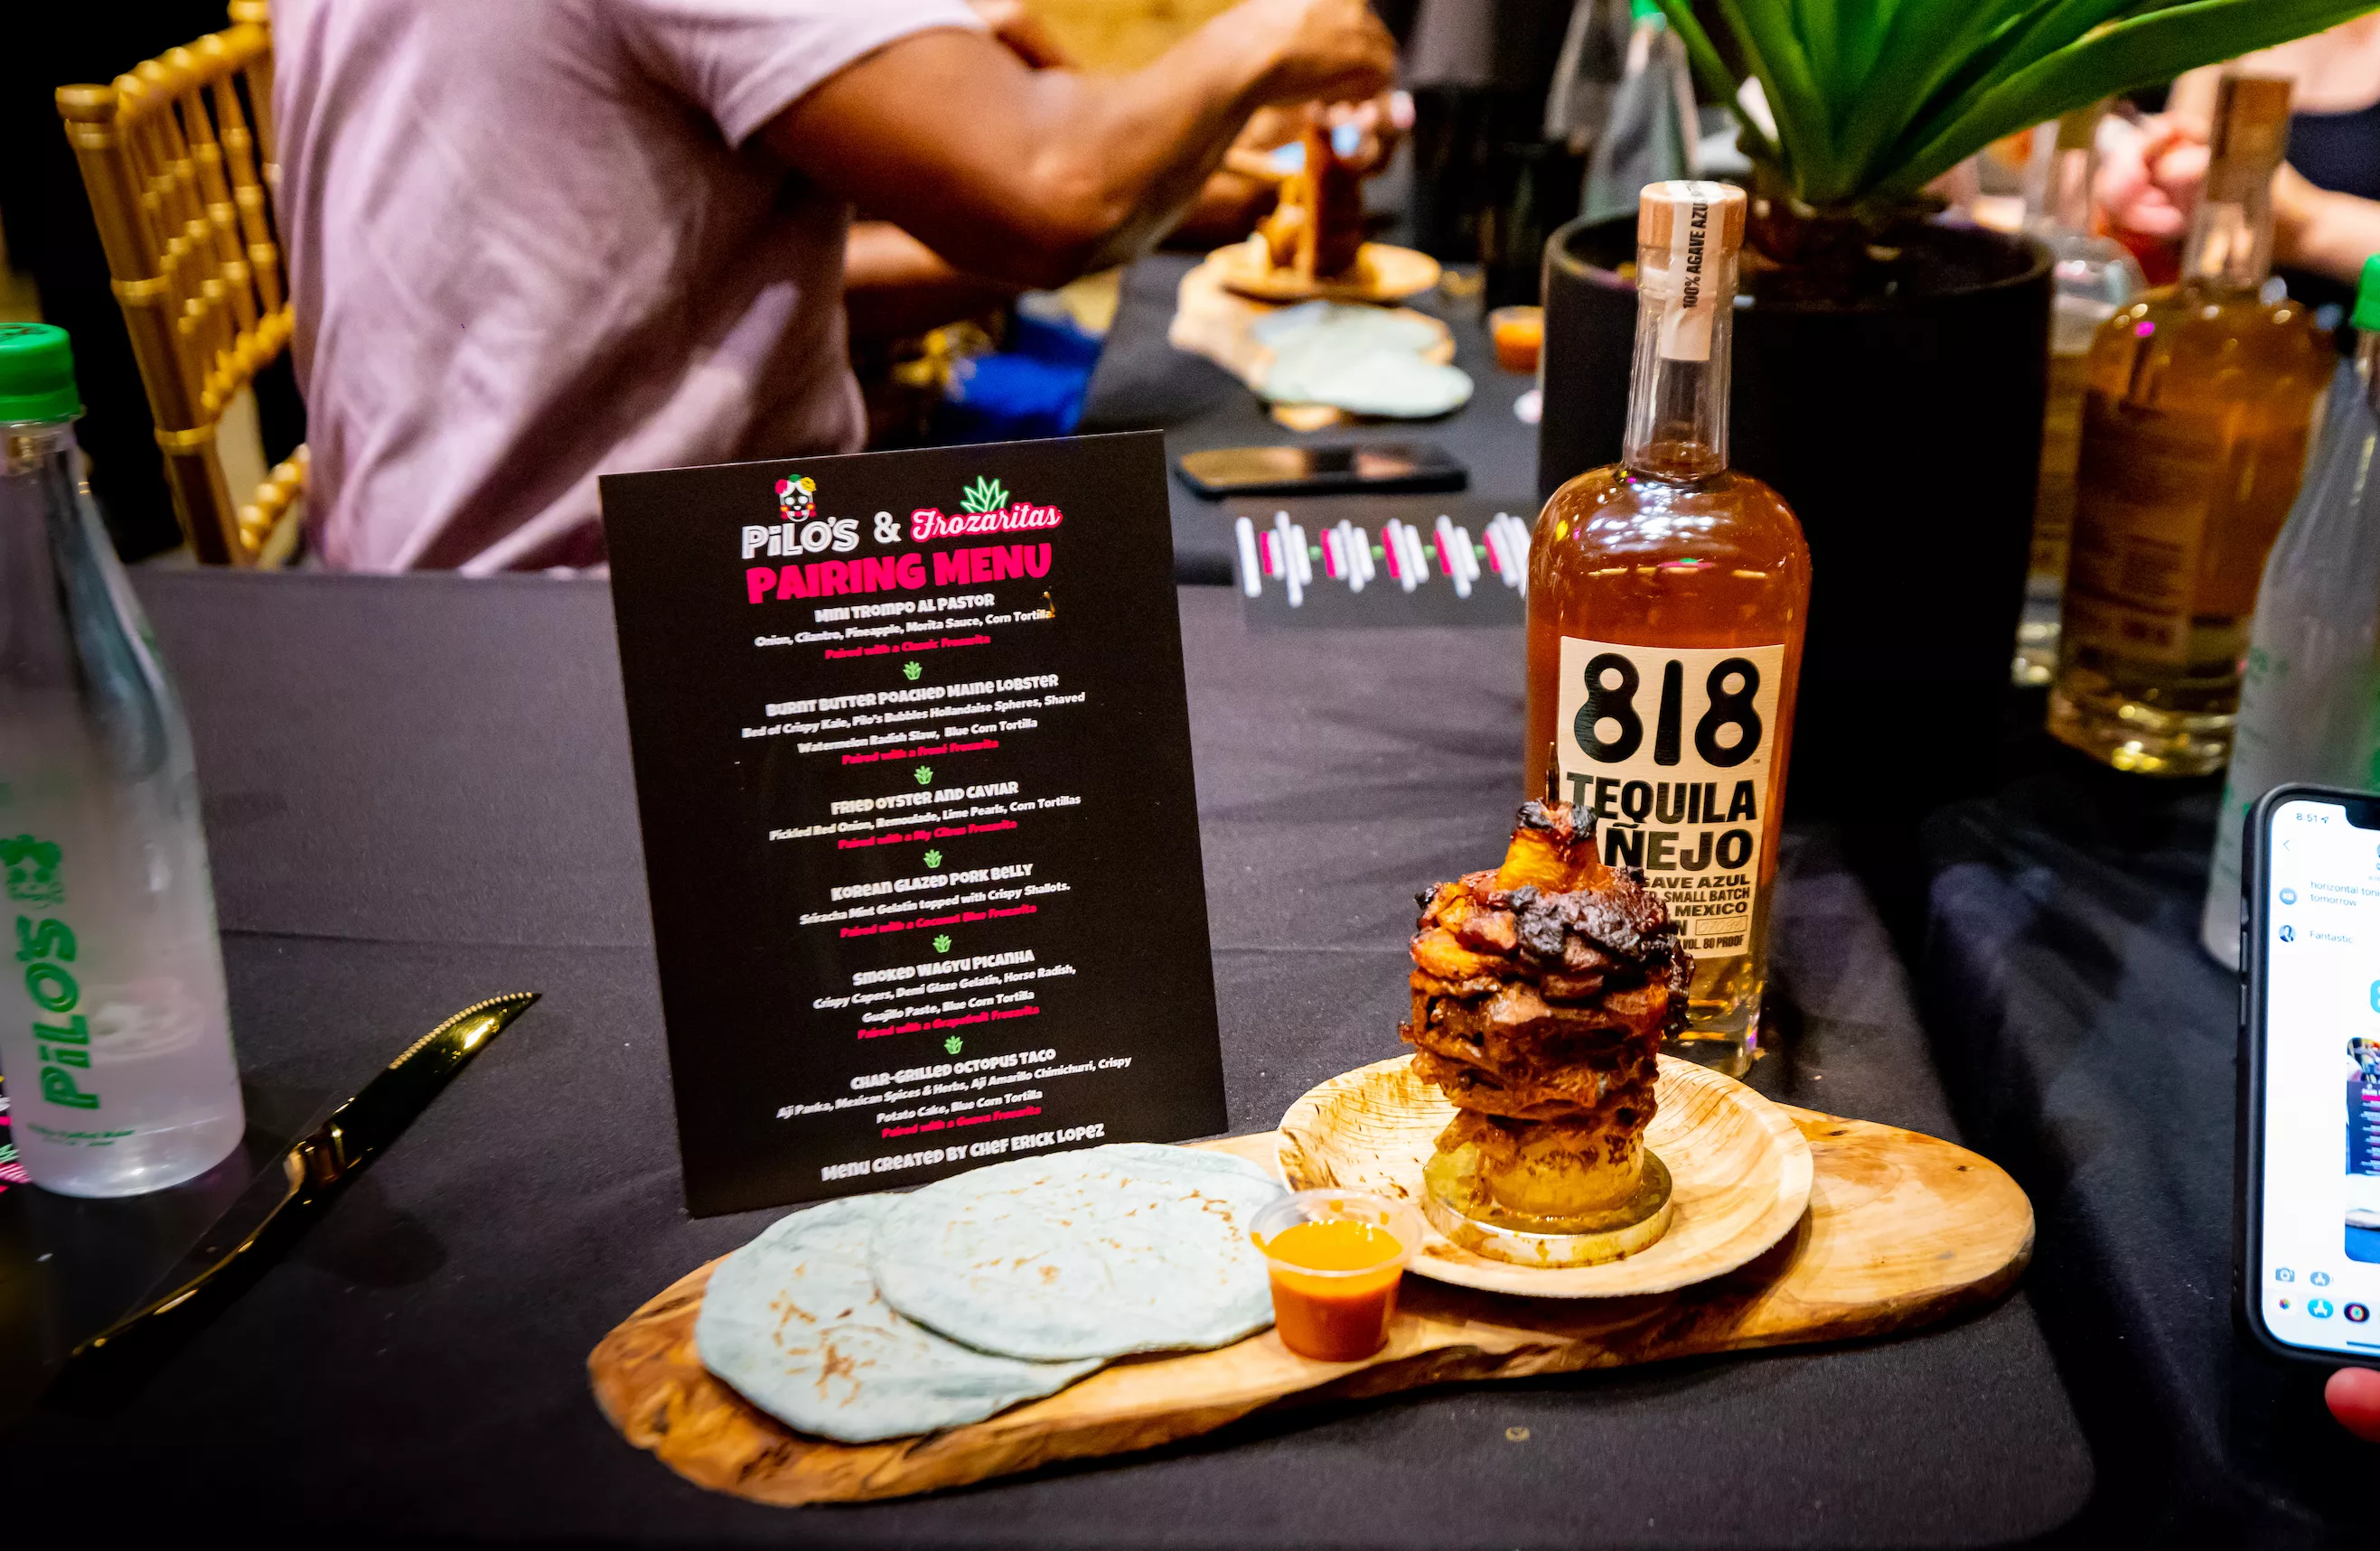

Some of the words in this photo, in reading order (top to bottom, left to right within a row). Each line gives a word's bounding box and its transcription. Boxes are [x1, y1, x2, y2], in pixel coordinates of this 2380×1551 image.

[1687, 230, 1706, 274] AGAVE
[1683, 276, 1701, 308] 100%
[873, 511, 902, 543] &
[912, 502, 1063, 542] Frozaritas
[745, 552, 927, 604] PAIRING
[932, 543, 1053, 586] MENU
[845, 624, 904, 639] Pineapple,
[905, 620, 944, 632] Morita
[945, 618, 983, 629] Sauce,
[985, 614, 1012, 624] Corn
[767, 724, 782, 735] of
[782, 722, 820, 733] Crispy
[852, 714, 884, 726] Pilo's
[884, 710, 929, 723] Bubbles
[930, 702, 993, 718] Hollandaise
[994, 699, 1043, 713] Spheres,
[1044, 692, 1085, 705] Shaved
[1574, 652, 1763, 767] 818
[797, 737, 869, 753] Watermelon
[908, 731, 941, 741] Slaw,
[944, 726, 970, 737] Blue
[970, 724, 998, 734] Corn
[998, 718, 1038, 731] Tortilla
[1567, 771, 1757, 824] TEQUILA
[812, 823, 837, 836] Red
[942, 808, 969, 820] Lime
[970, 804, 1007, 817] Pearls,
[1009, 801, 1035, 812] Corn
[1037, 796, 1082, 808] Tortillas
[1604, 822, 1754, 872] ÑEJO
[876, 901, 918, 915] Gelatin
[918, 894, 960, 911] topped
[960, 892, 987, 903] with
[987, 888, 1023, 901] Crispy
[1024, 882, 1071, 896] Shallots.
[1644, 876, 1694, 889] GAVE
[1697, 874, 1750, 889] AZUL
[1663, 891, 1707, 904] SMALL
[1710, 887, 1750, 902] BATCH
[2310, 881, 2358, 894] horizontal
[2361, 888, 2380, 897] toni
[1674, 902, 1748, 917] MEXICO
[2310, 893, 2357, 906] tomorrow
[1703, 937, 1715, 949] 80
[1717, 934, 1745, 948] PROOF
[2310, 930, 2354, 943] Fantastic
[813, 996, 850, 1009] Crispy
[851, 991, 895, 1004] Capers,
[895, 984, 925, 998] Demi
[926, 982, 958, 994] Glaze
[959, 974, 1003, 989] Gelatin,
[1004, 971, 1036, 983] Horse
[1037, 964, 1076, 978] Radish,
[904, 1004, 942, 1017] Paste,
[942, 1001, 967, 1012] Blue
[968, 997, 995, 1008] Corn
[995, 990, 1035, 1004] Tortilla
[884, 1089, 921, 1103] Spices
[922, 1085, 932, 1096] &
[932, 1081, 970, 1095] Herbs,
[1034, 1060, 1096, 1079] Chimichurri,
[1098, 1057, 1132, 1069] Crispy
[876, 1109, 916, 1124] Potato
[917, 1105, 950, 1117] Cake,
[951, 1101, 975, 1112] Blue
[976, 1097, 1003, 1107] Corn
[1004, 1089, 1043, 1104] Tortilla
